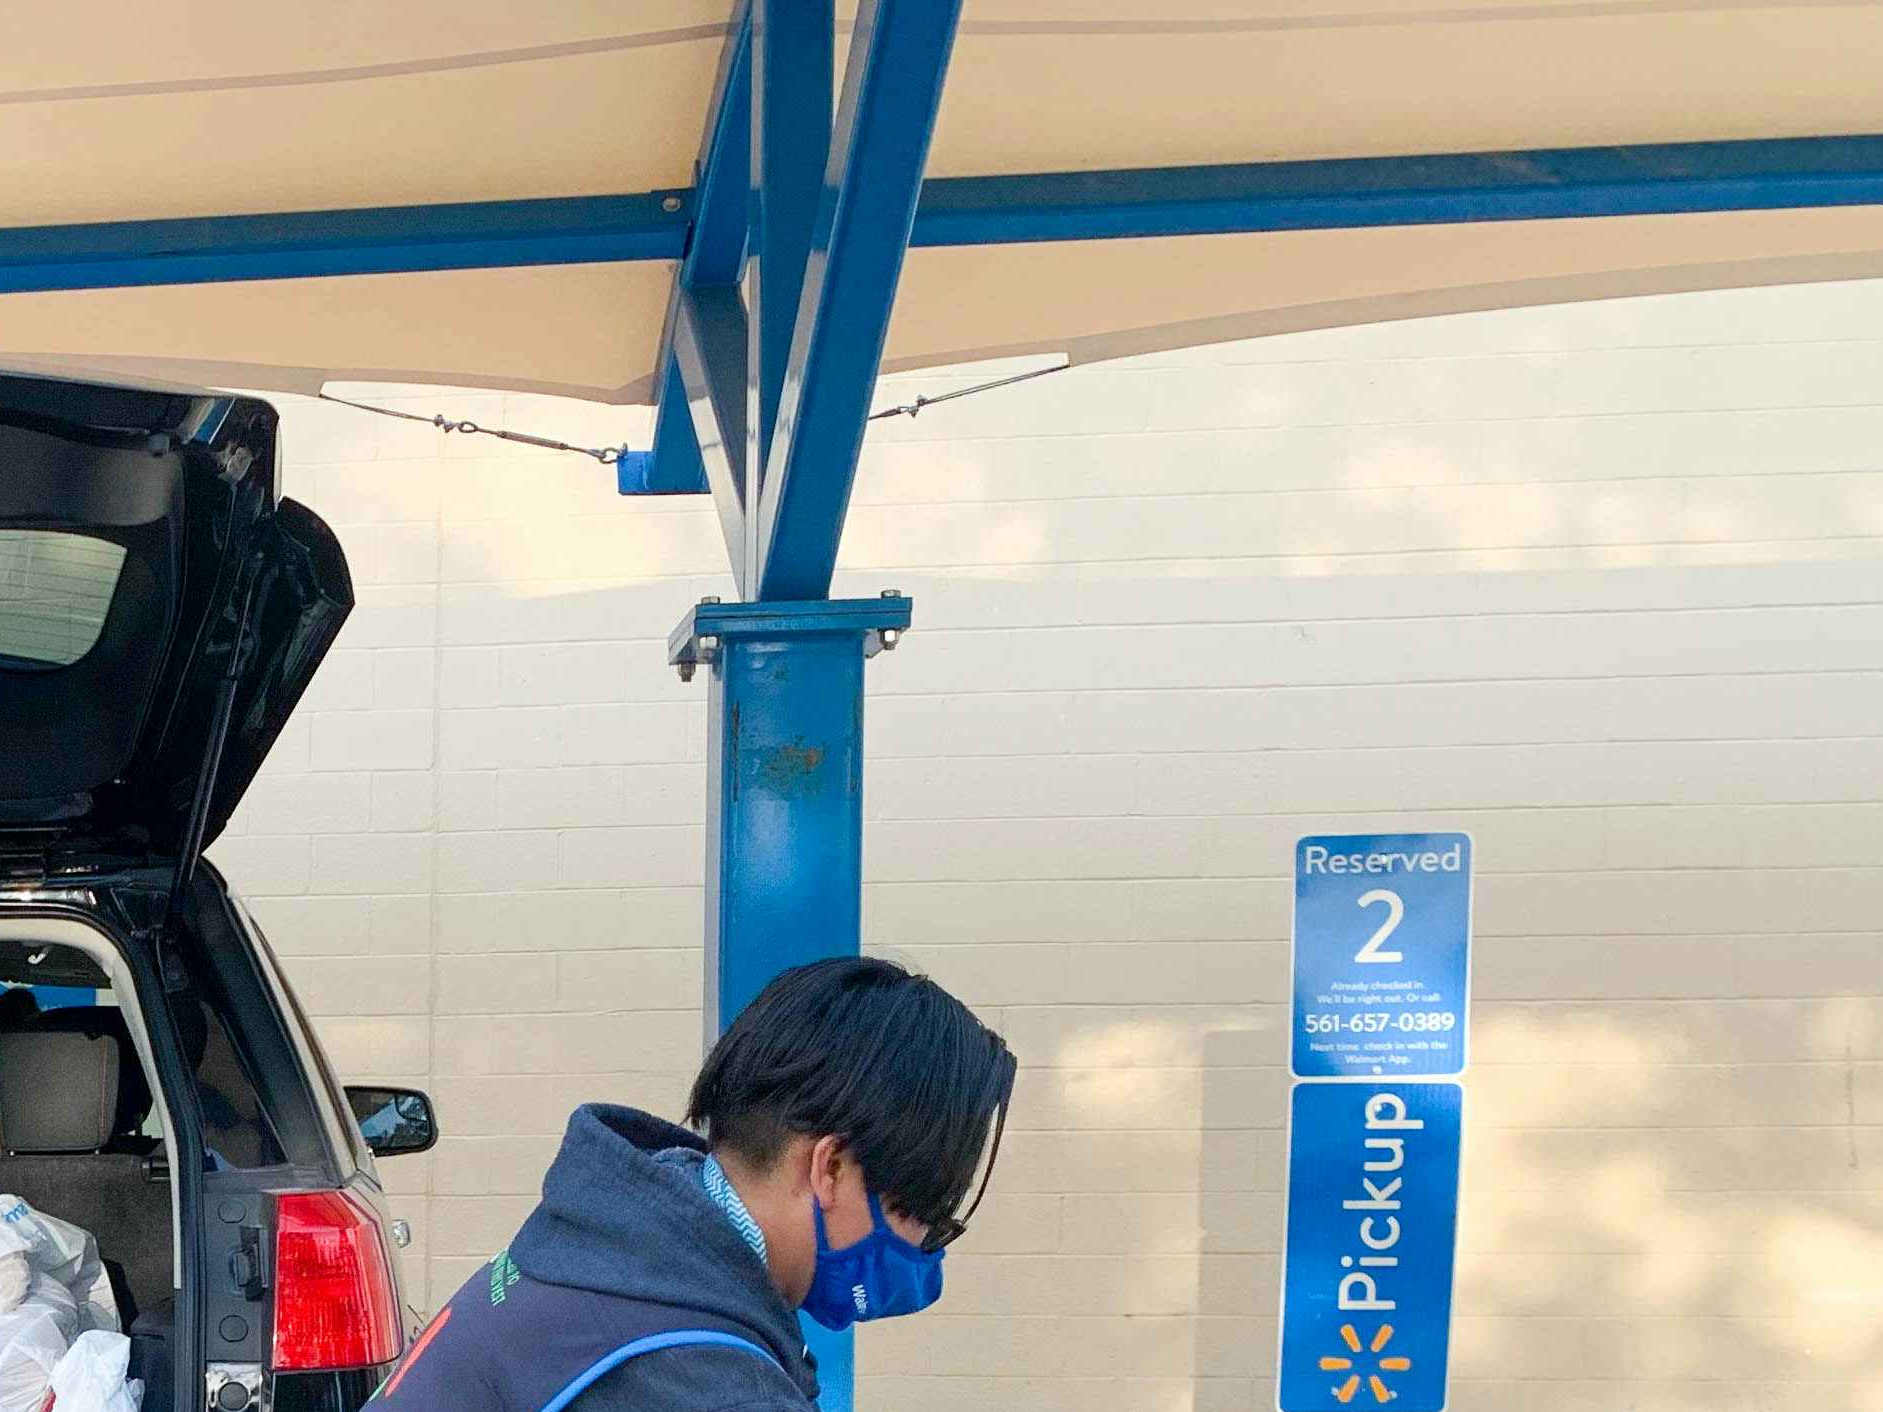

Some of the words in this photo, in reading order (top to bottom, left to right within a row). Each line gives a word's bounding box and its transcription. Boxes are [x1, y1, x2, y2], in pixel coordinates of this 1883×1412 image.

[1304, 843, 1462, 874] Reserved
[1354, 888, 1405, 964] 2
[1304, 1012, 1455, 1033] 561-657-0389
[1337, 1092, 1425, 1311] Pickup
